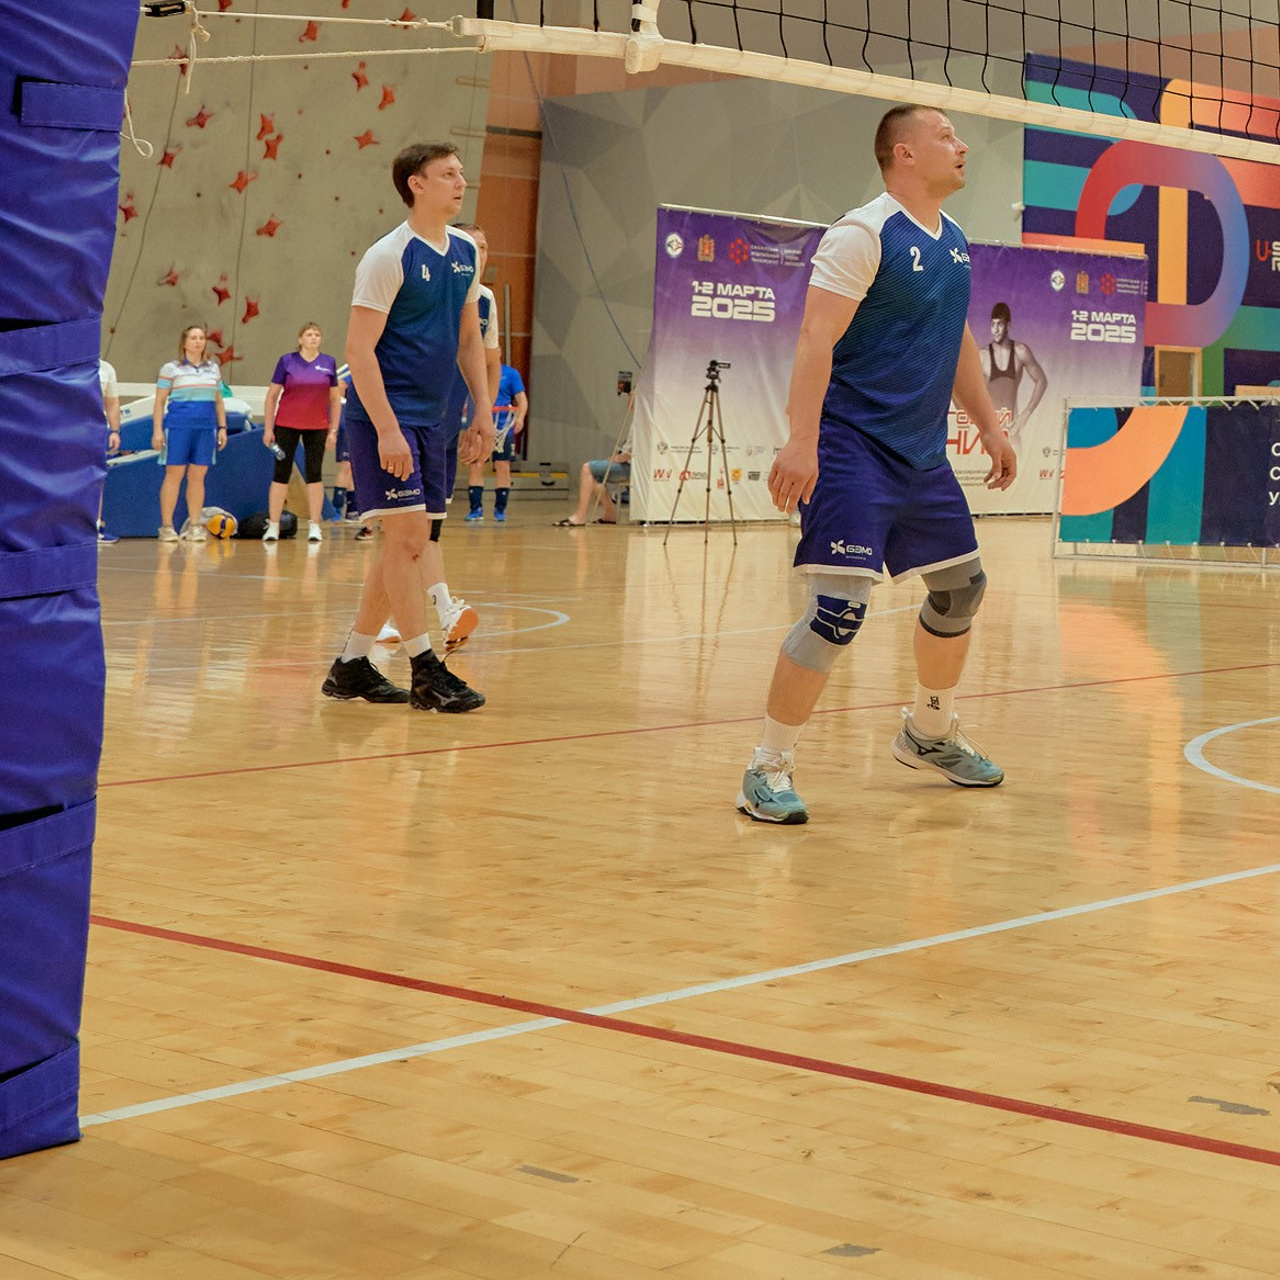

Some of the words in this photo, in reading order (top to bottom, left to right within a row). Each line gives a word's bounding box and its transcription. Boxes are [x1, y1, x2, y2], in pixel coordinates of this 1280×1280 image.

[910, 246, 924, 271] 2
[421, 264, 431, 281] 4
[717, 283, 776, 300] МАРТА
[691, 295, 776, 322] 2025
[1091, 311, 1136, 324] МАРТА
[1070, 322, 1136, 343] 2025
